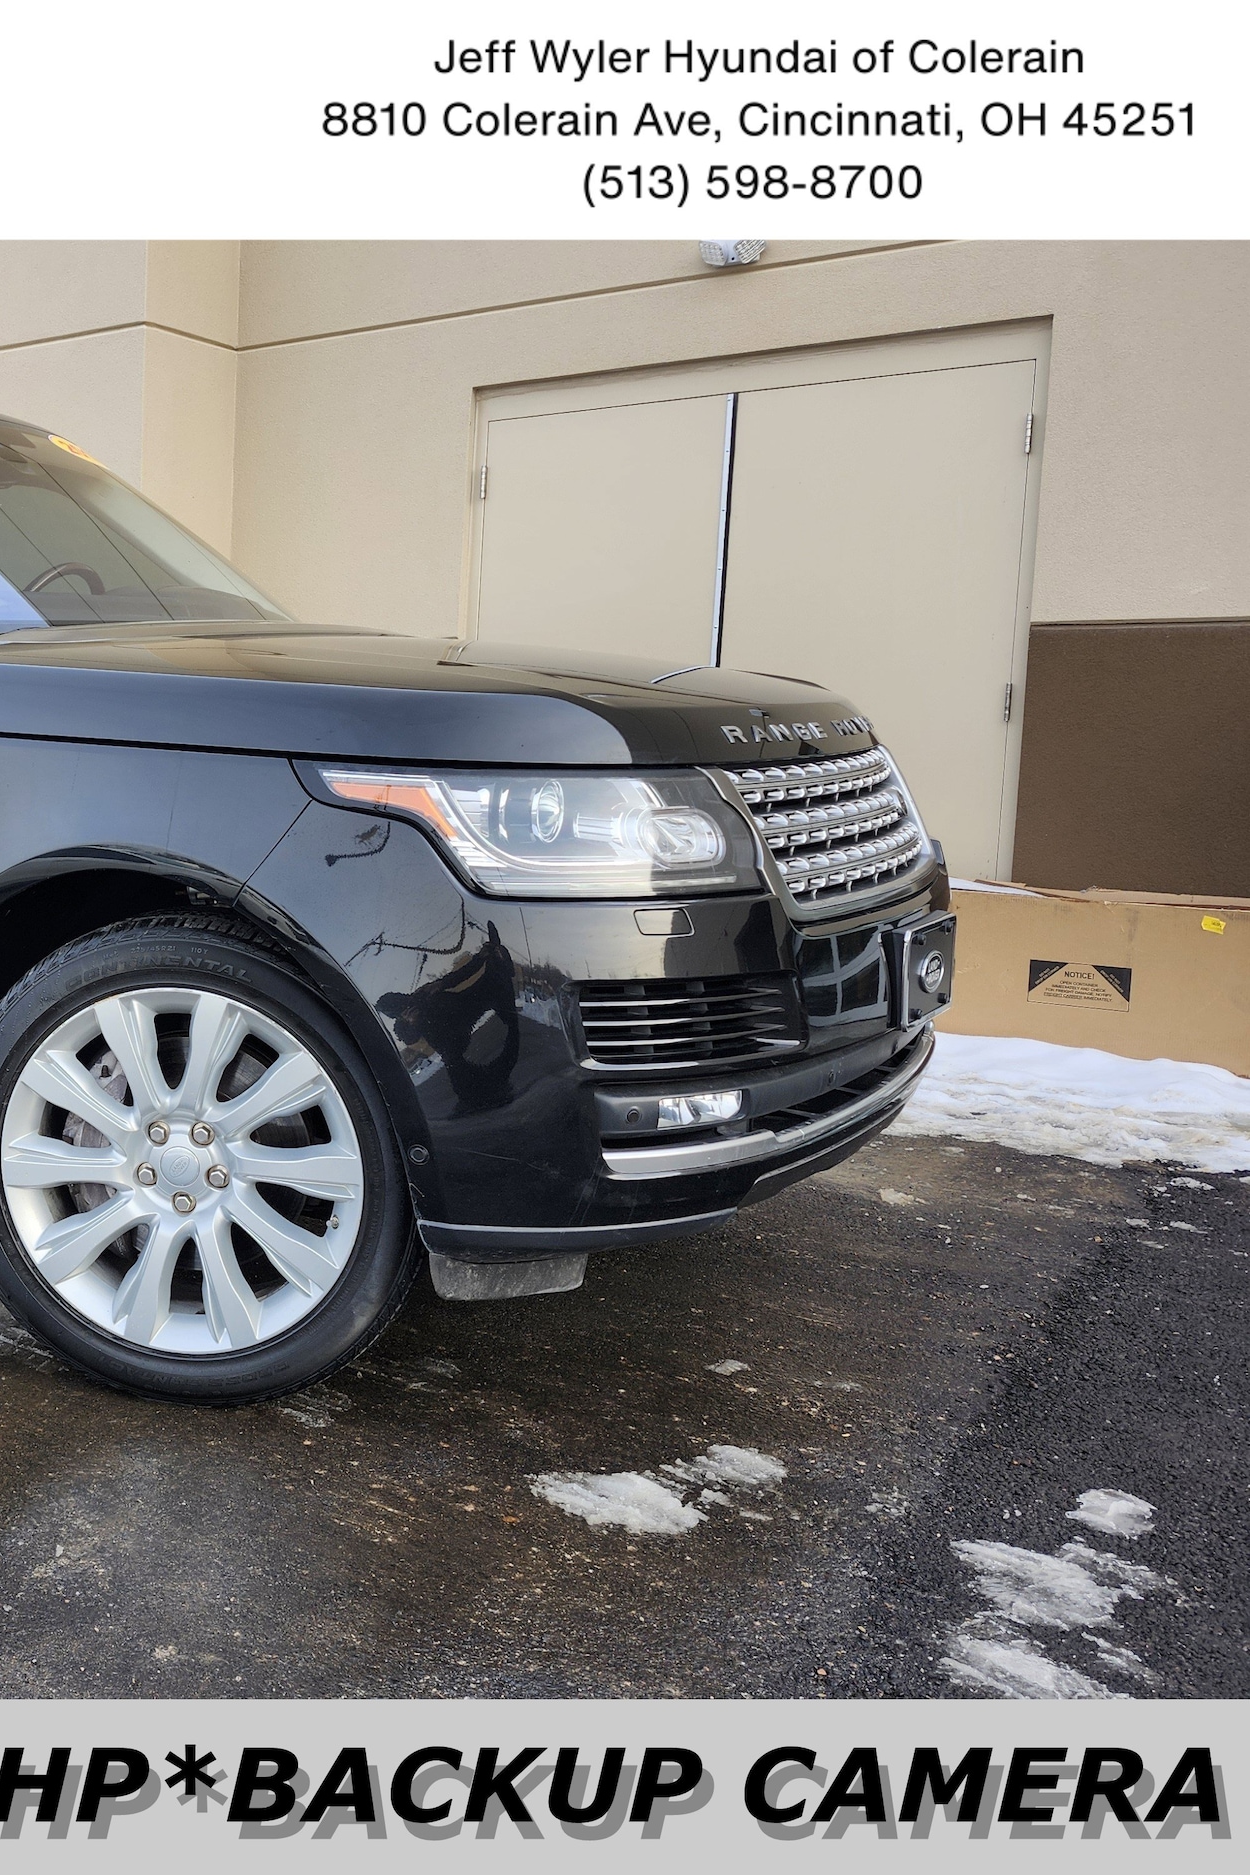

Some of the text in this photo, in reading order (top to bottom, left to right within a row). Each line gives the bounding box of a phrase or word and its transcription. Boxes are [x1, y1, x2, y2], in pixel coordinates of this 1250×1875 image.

[720, 716, 875, 744] RANGE ROVE
[65, 954, 252, 992] CONTINENTAL
[1064, 971, 1095, 980] NOTICE!
